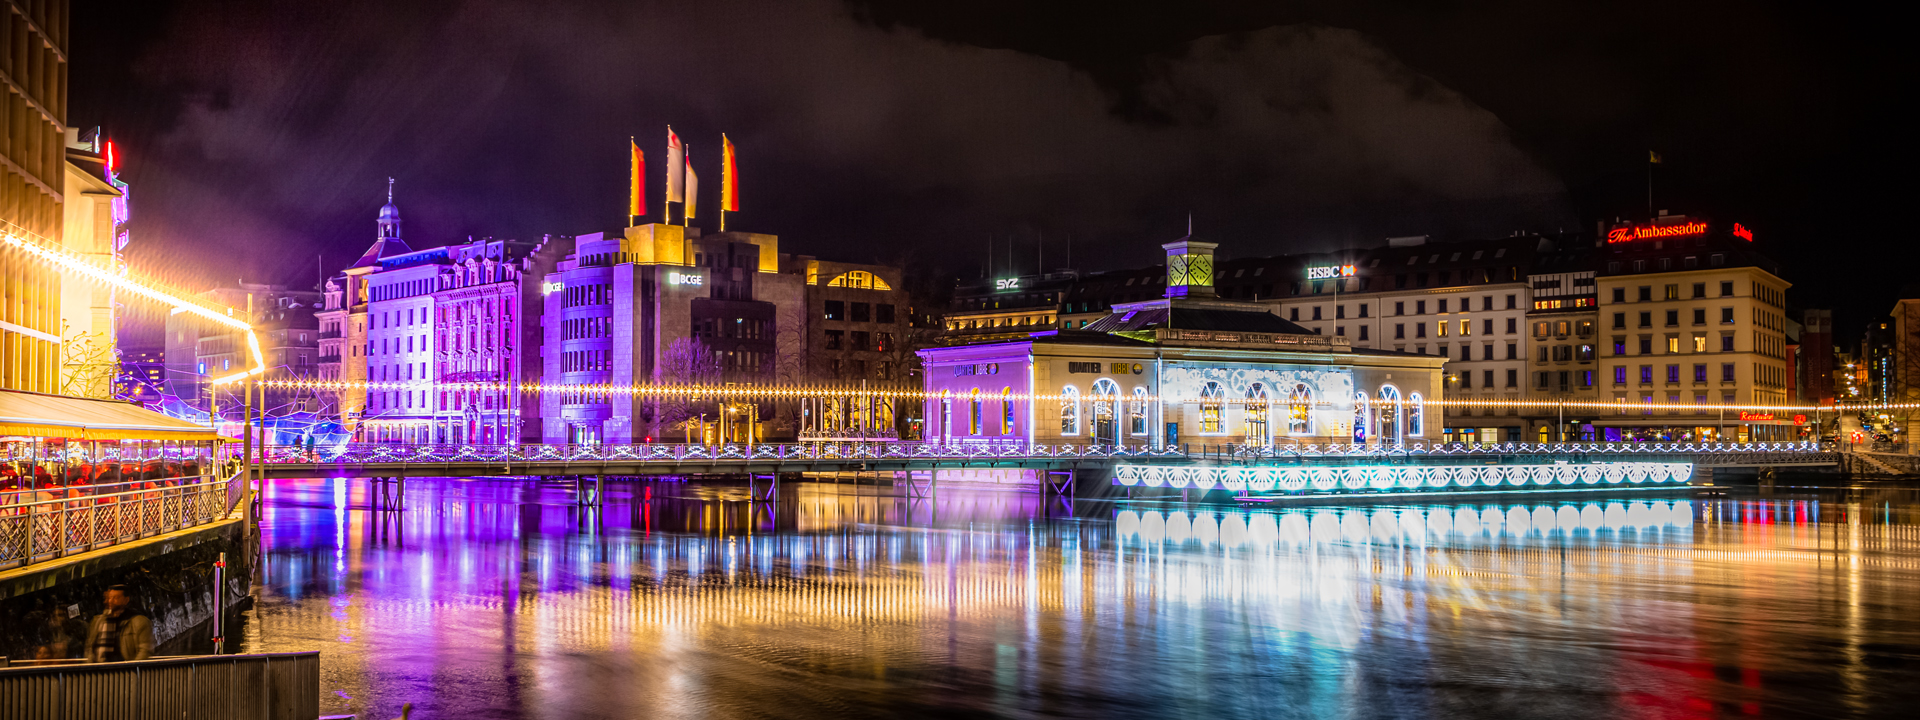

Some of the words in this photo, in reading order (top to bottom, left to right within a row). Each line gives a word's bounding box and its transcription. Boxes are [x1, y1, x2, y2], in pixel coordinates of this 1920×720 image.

[1608, 227, 1634, 243] The
[1634, 221, 1707, 239] Ambassador
[1307, 265, 1340, 279] HSBC
[680, 274, 702, 286] BCGE
[996, 278, 1019, 290] SYZ
[1111, 362, 1130, 375] LIBRE
